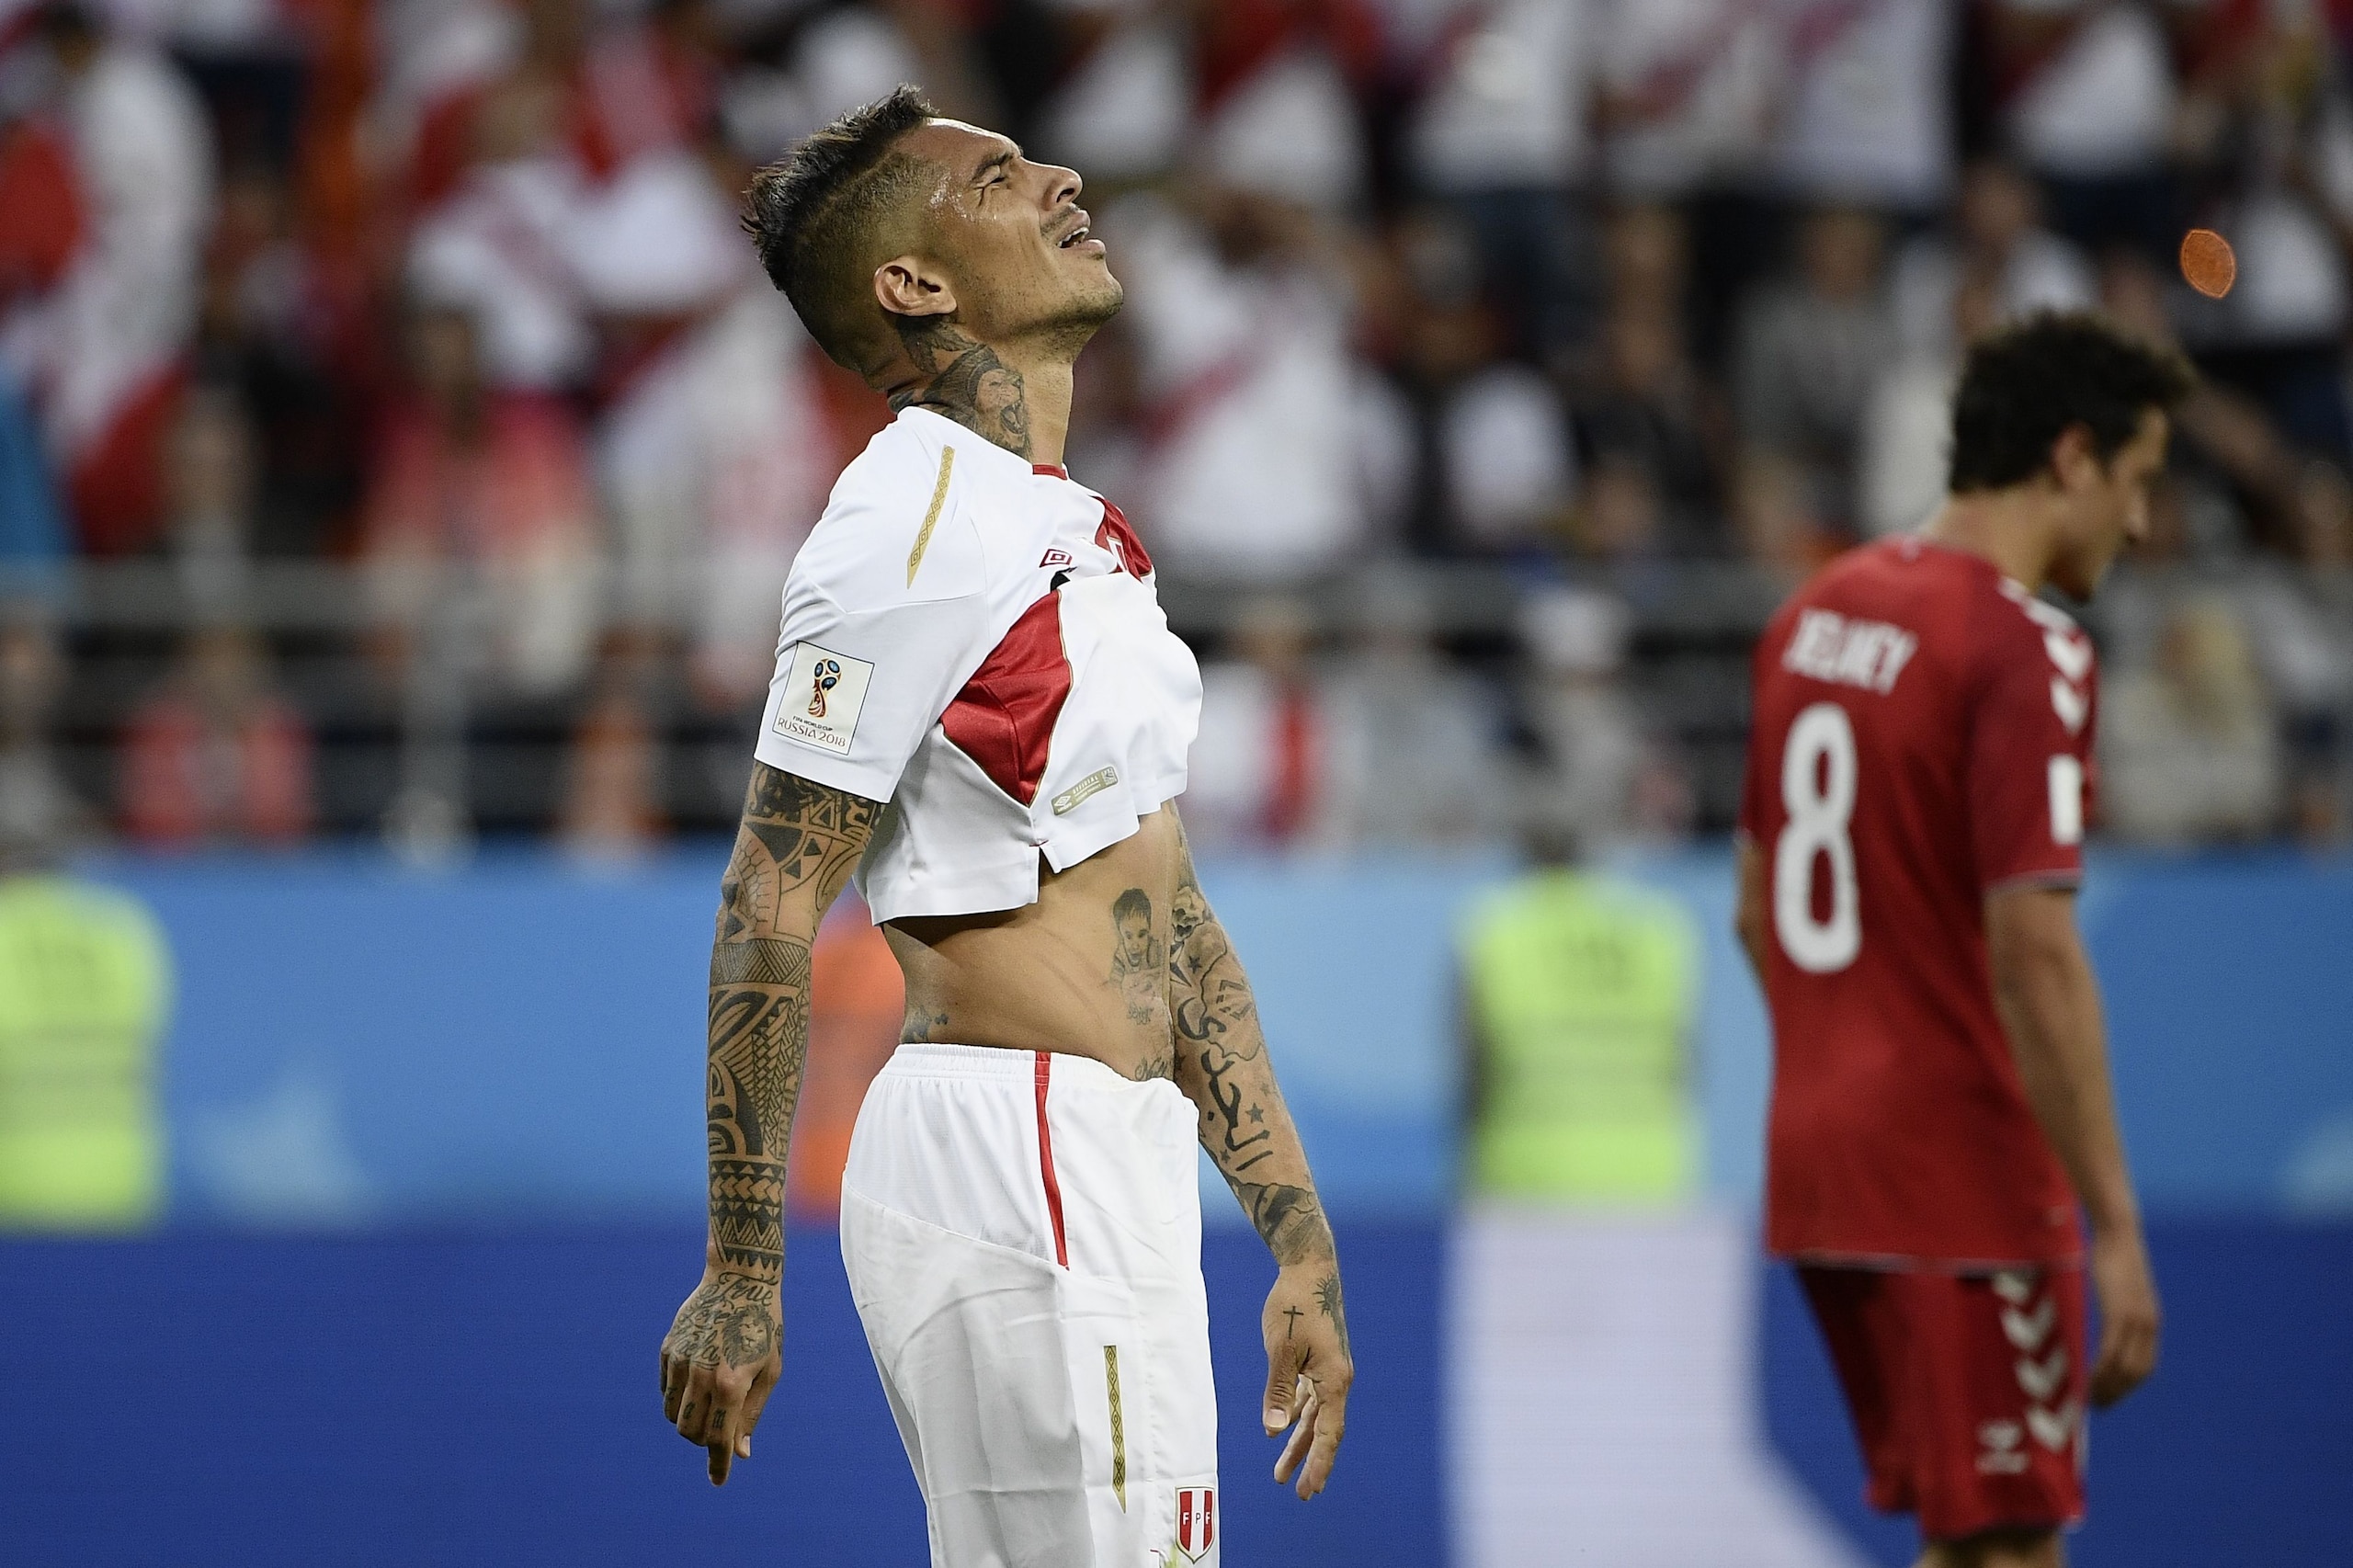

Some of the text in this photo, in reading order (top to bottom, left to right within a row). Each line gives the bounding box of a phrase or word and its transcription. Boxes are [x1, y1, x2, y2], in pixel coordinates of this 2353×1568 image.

[778, 717, 846, 747] RUSSIA 2018
[803, 720, 823, 730] WORLD
[1775, 702, 1861, 972] 8
[718, 1272, 779, 1306] True
